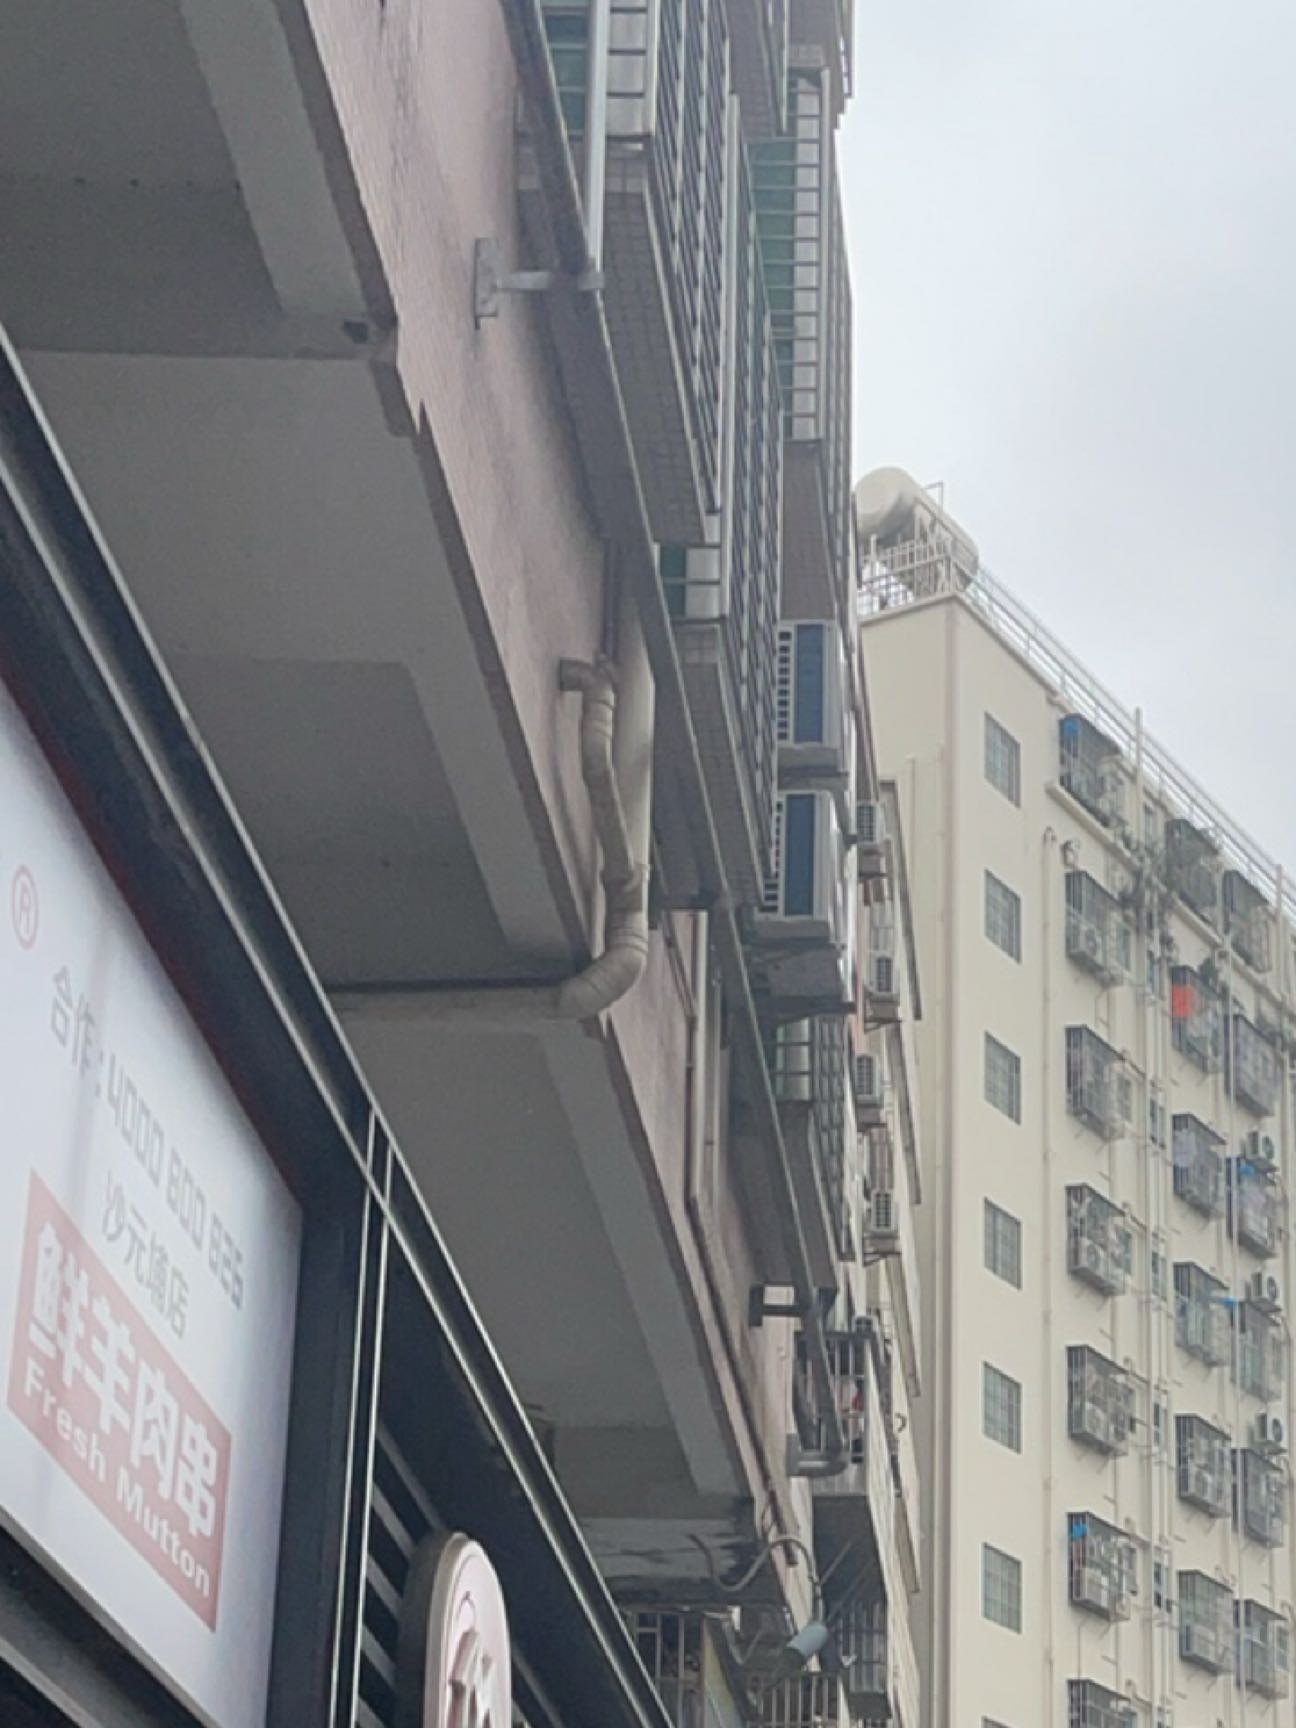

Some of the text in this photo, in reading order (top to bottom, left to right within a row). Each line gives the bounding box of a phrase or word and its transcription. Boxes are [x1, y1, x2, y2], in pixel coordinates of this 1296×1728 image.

[23, 1354, 211, 1598] Fresh Mutton
[28, 1221, 218, 1538] 鲜羊肉串
